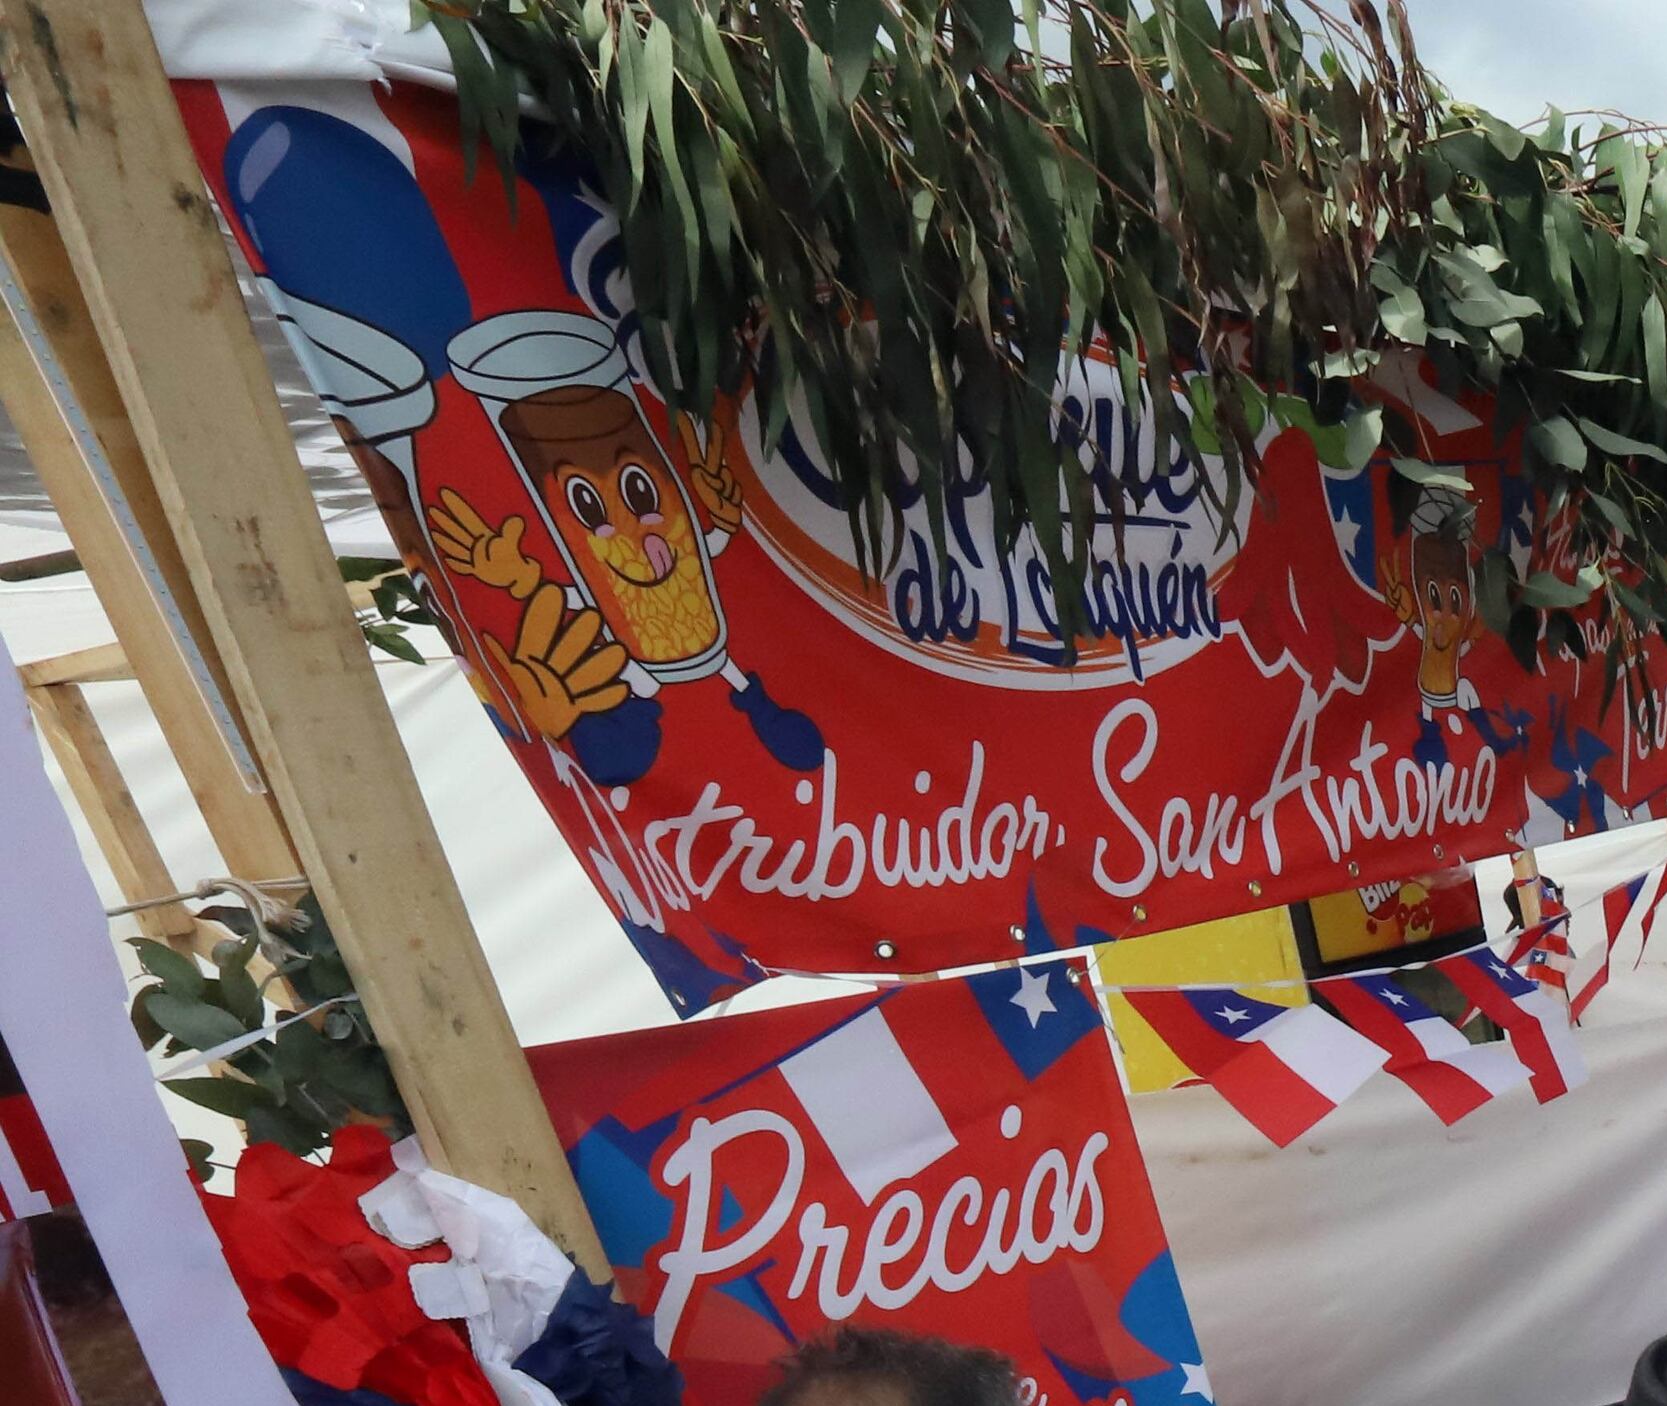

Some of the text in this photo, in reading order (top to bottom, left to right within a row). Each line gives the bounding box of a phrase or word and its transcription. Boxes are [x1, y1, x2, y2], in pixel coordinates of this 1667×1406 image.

[895, 529, 1222, 683] de Loquén
[1091, 698, 1247, 898] San
[1249, 683, 1497, 876] Antonio
[655, 1106, 1108, 1357] Precios
